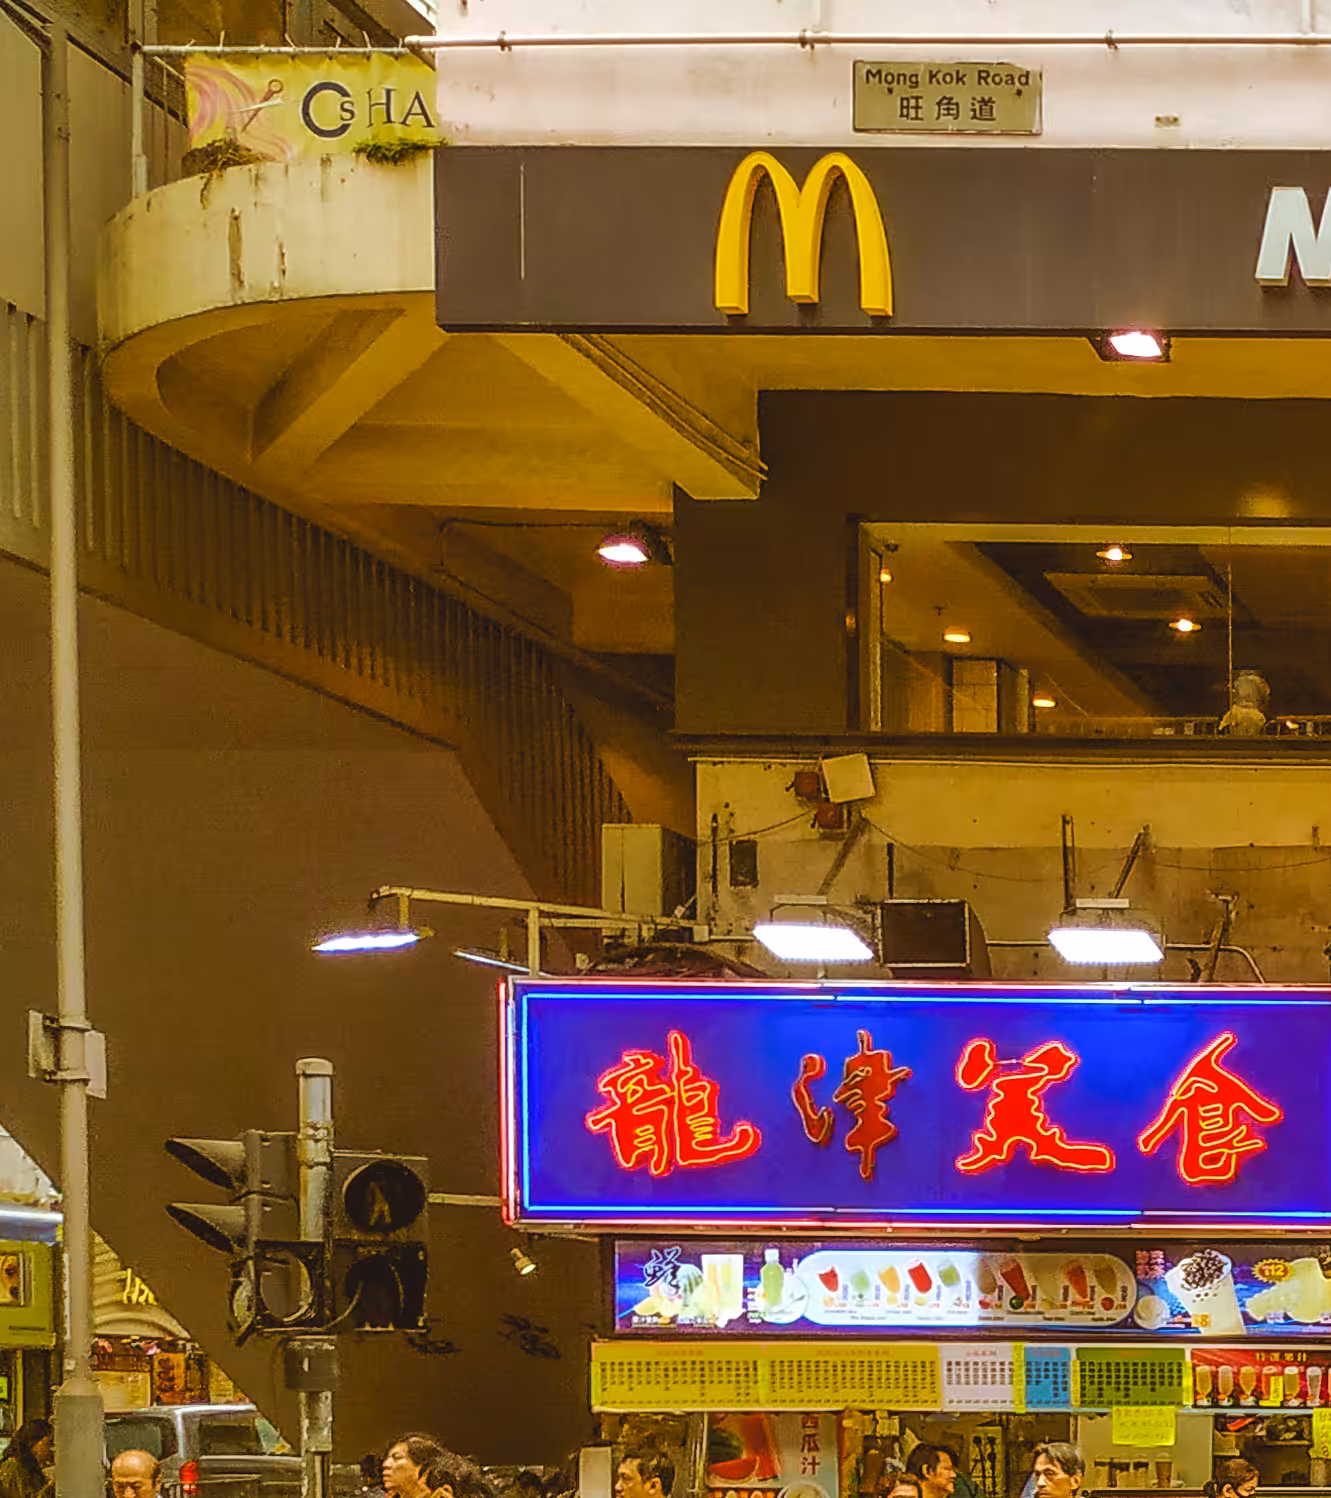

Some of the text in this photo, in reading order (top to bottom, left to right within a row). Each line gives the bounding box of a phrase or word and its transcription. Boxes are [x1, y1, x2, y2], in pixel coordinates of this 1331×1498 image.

[865, 69, 1030, 88] Mong Kok Road
[898, 95, 997, 122] 旺角道
[585, 1028, 1284, 1186] 龍津美食
[800, 1414, 821, 1475] 西瓜汁
